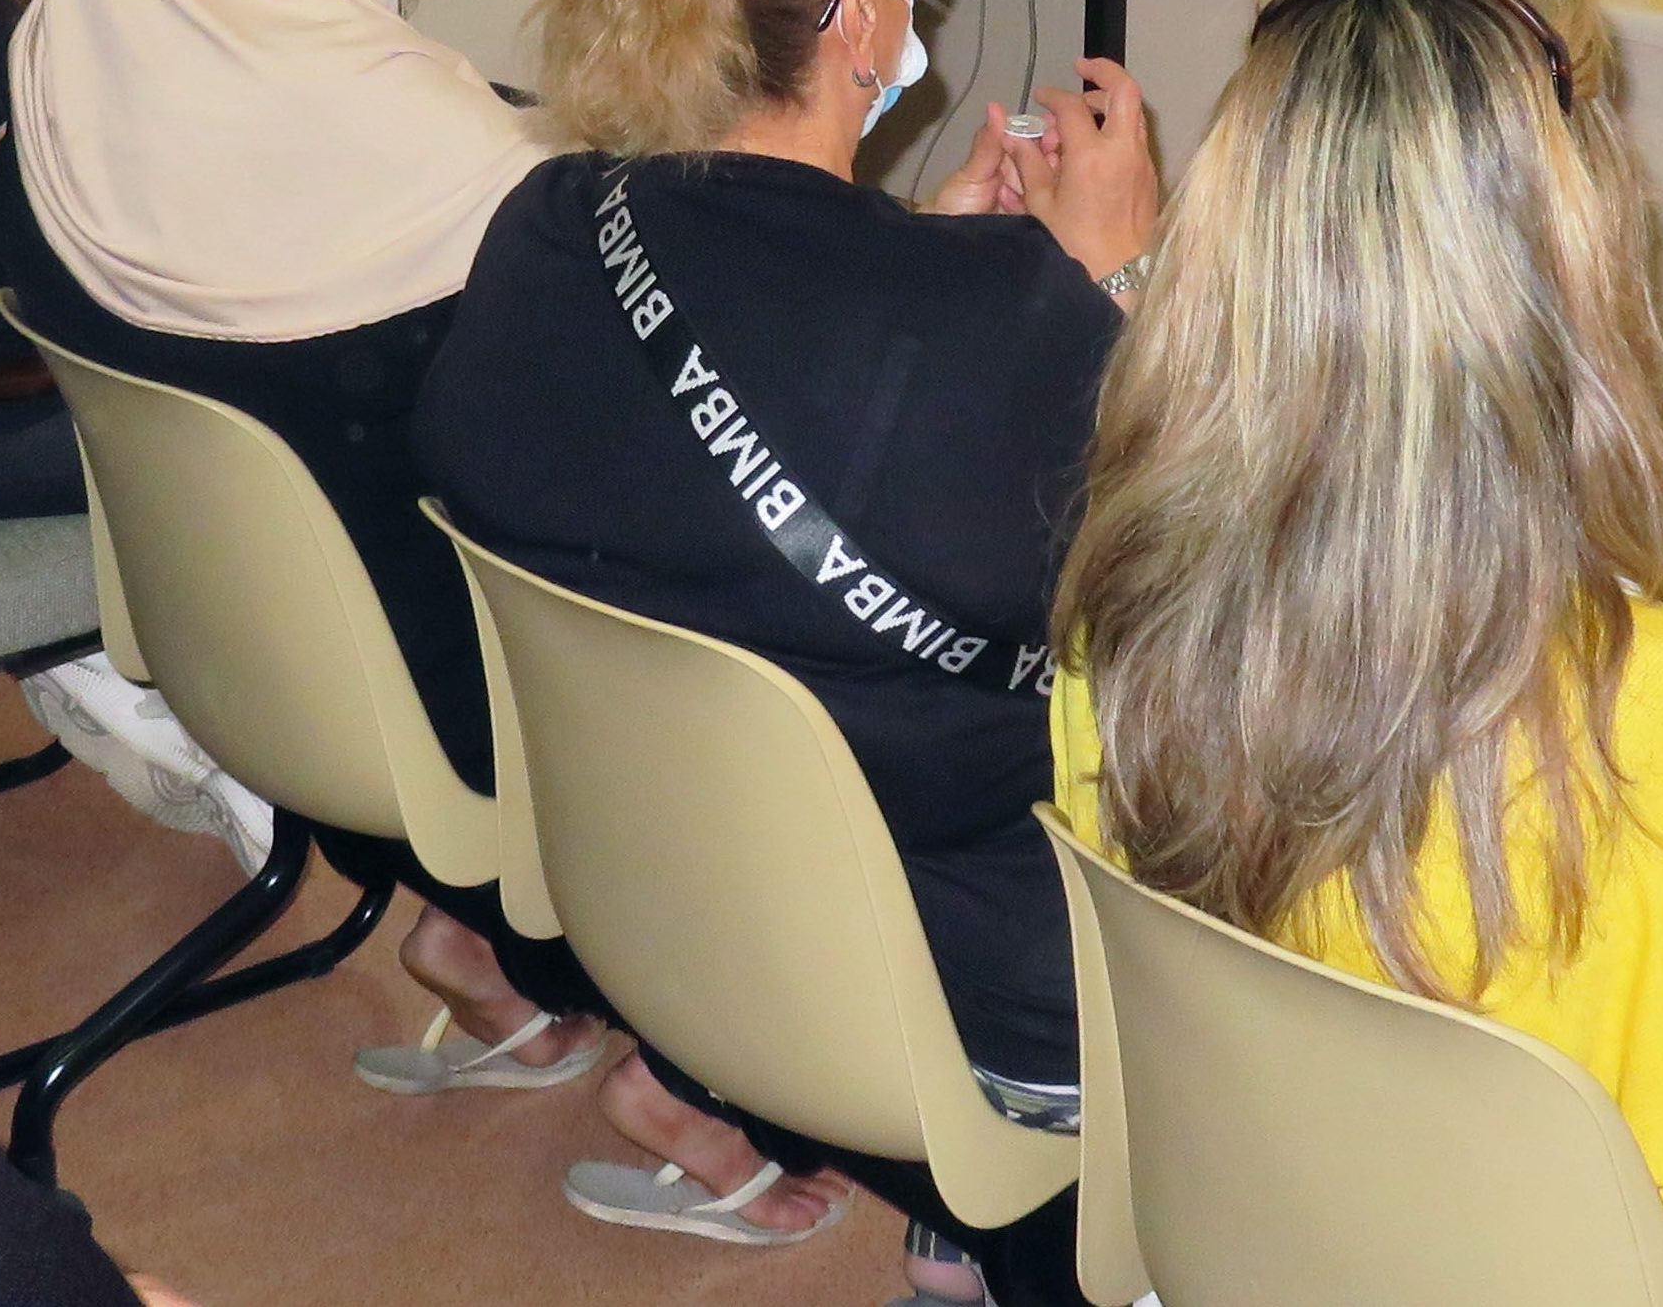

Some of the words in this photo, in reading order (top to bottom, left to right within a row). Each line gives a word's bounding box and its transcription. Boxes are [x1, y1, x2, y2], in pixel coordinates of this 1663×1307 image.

[594, 173, 675, 341] BIMBA
[670, 343, 807, 532] BIMBA
[815, 534, 989, 674] BIMBA
